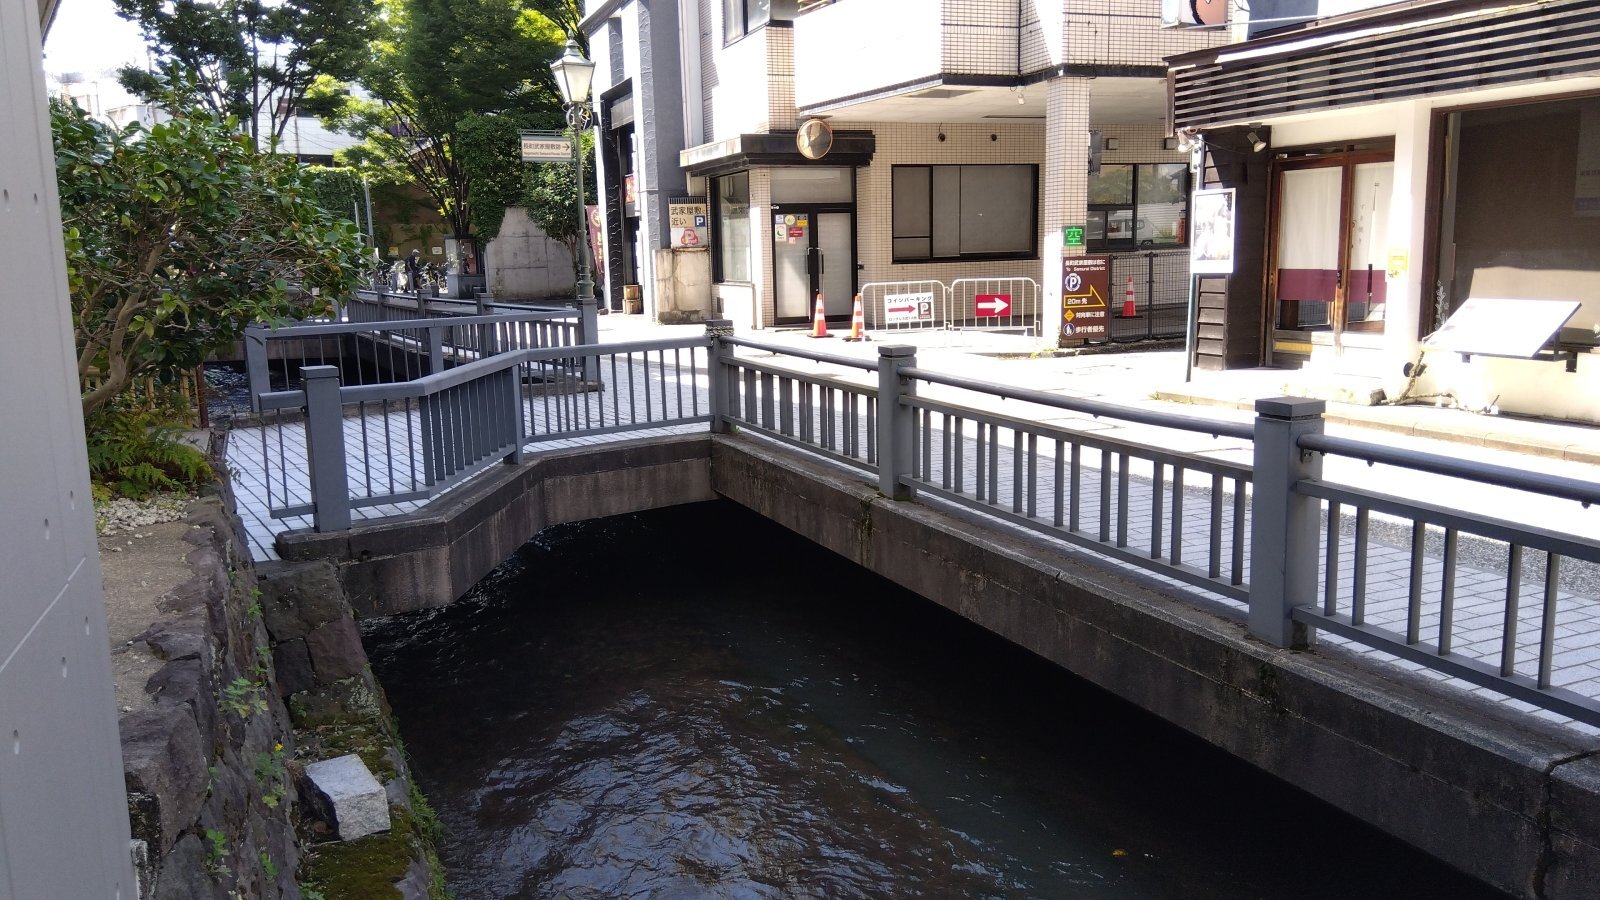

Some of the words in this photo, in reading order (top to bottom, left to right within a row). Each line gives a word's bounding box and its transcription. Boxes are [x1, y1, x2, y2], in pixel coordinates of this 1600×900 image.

[696, 217, 703, 225] P
[1065, 227, 1083, 245] 空
[1070, 277, 1077, 288] P
[920, 303, 929, 314] P
[1075, 325, 1105, 334] 歩行者優先
